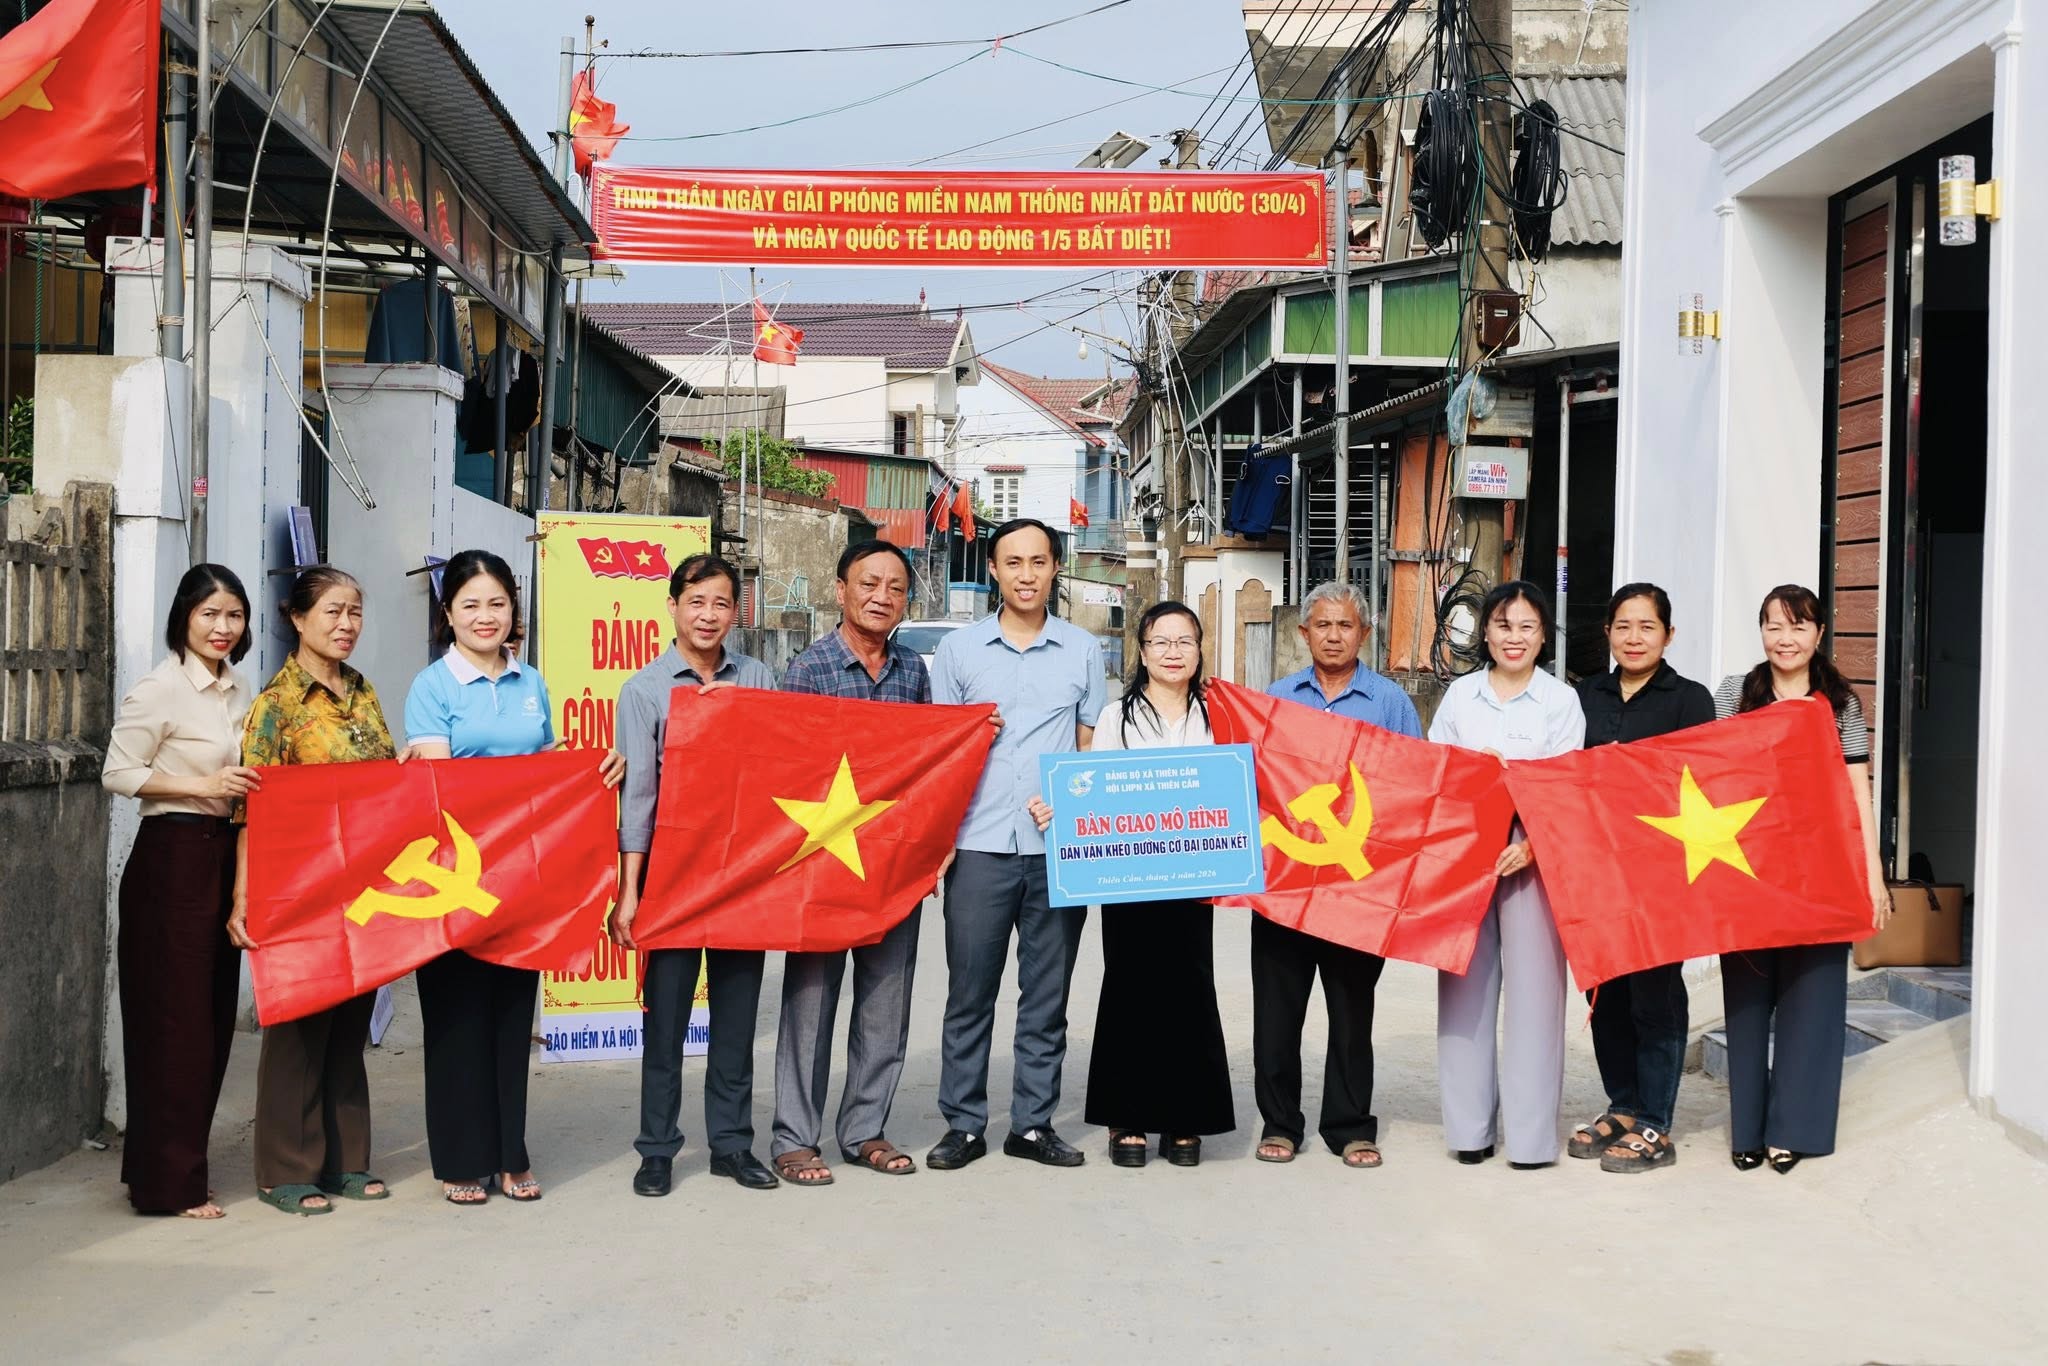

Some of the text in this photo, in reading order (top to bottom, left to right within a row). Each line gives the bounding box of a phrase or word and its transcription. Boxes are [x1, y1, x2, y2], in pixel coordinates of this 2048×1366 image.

[613, 182, 1306, 216] TINH THẦN NGÀY GIẢI PHÓNG MIỀN NAM THỐNG NHẤT ĐẤT NƯỚC (30/4)
[753, 221, 1171, 255] VÀ NGÀY QUỐC TẾ LAO ĐỘNG 1/5 BẤT DIỆT!
[592, 601, 660, 670] ĐẢNG
[1105, 782, 1120, 794] HỘI
[1121, 782, 1142, 792] LHPN
[1129, 768, 1141, 781] BỘ
[1076, 806, 1229, 836] BÀN GIAO MÔ HÌNH
[1060, 833, 1248, 861] DÂN VẬN KHÉO ĐƯỜNG CỜ ĐẠI ĐOÀN KẾT
[1145, 872, 1168, 882] tháng
[1198, 870, 1217, 878] 2026
[546, 1026, 568, 1051] BẢO
[571, 1024, 598, 1049] HIỂM
[602, 1026, 616, 1048] XÃ
[619, 1025, 637, 1050] HỘI
